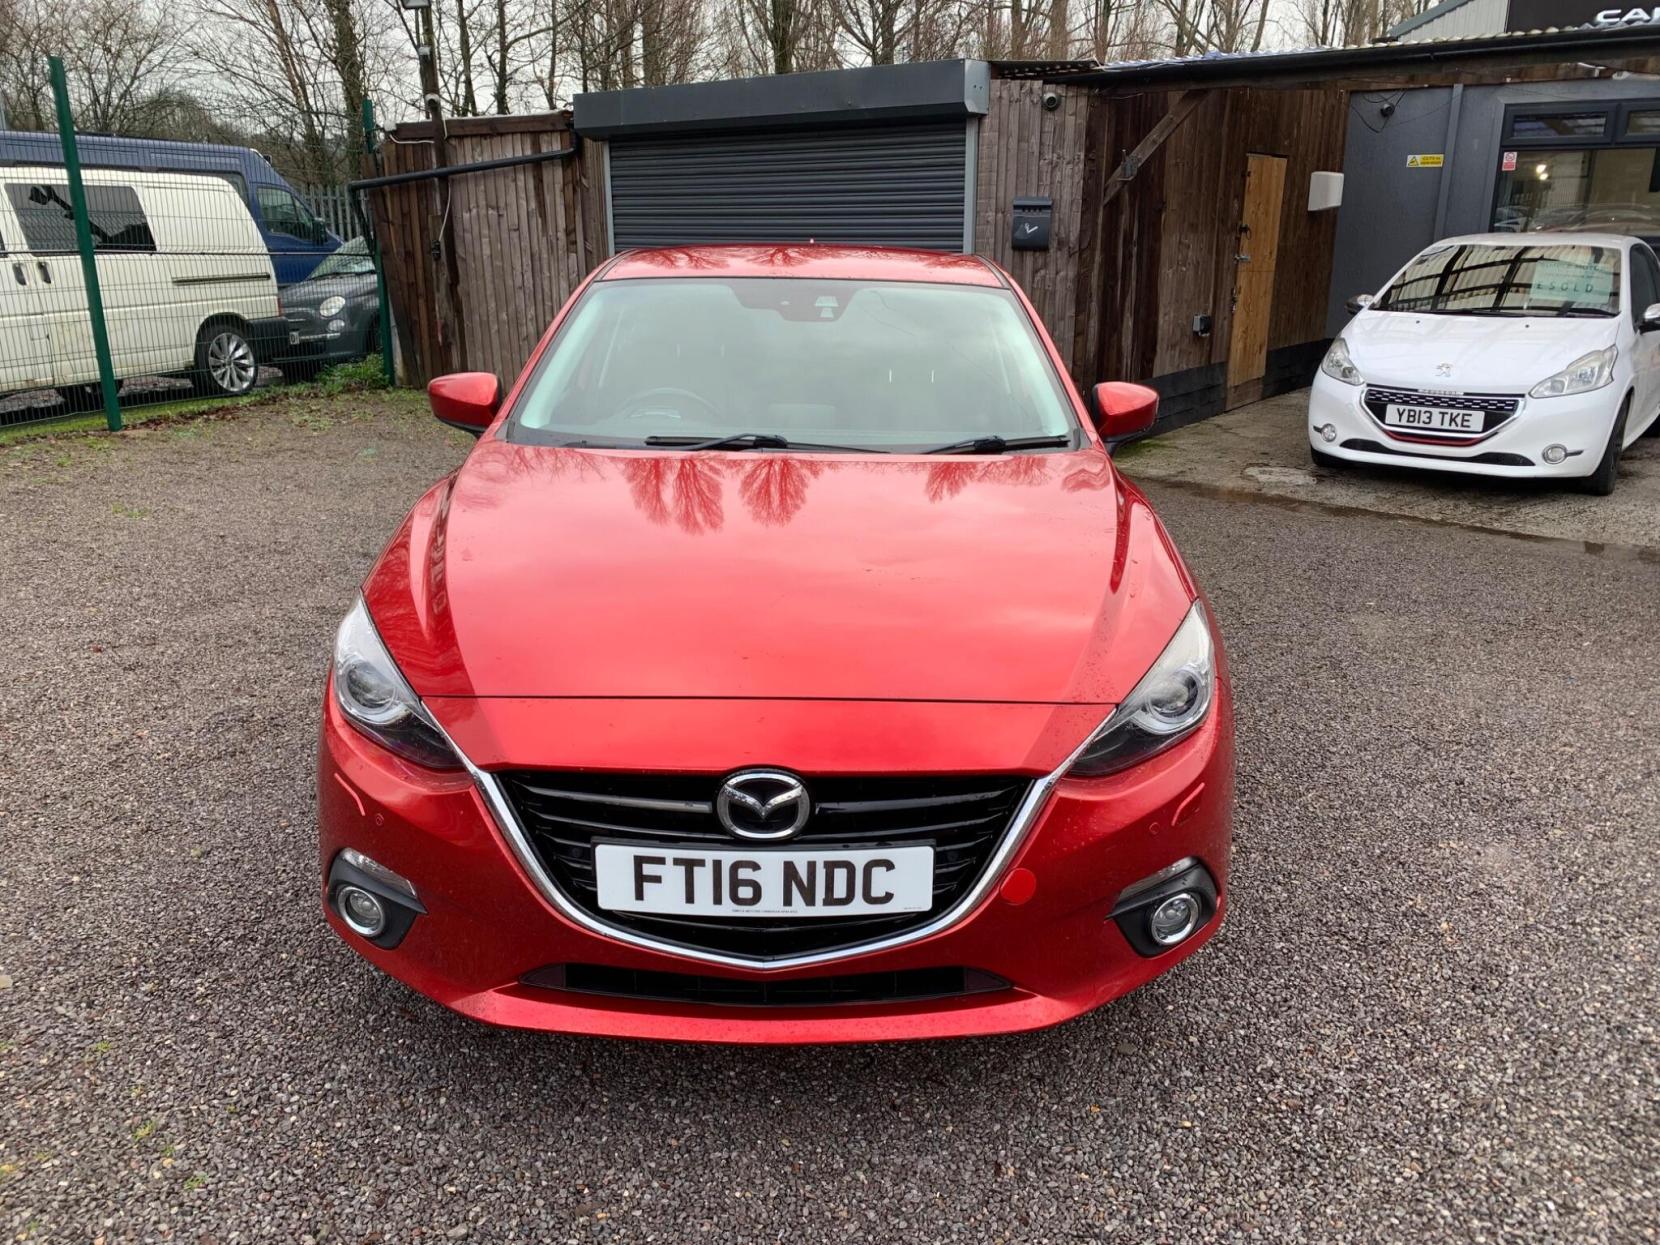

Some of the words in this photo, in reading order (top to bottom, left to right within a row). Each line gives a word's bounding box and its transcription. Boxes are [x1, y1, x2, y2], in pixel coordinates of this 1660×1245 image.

[1396, 407, 1433, 425] YB13
[1438, 411, 1472, 429] TKE
[633, 855, 762, 906] FT16
[782, 858, 896, 907] NDC
